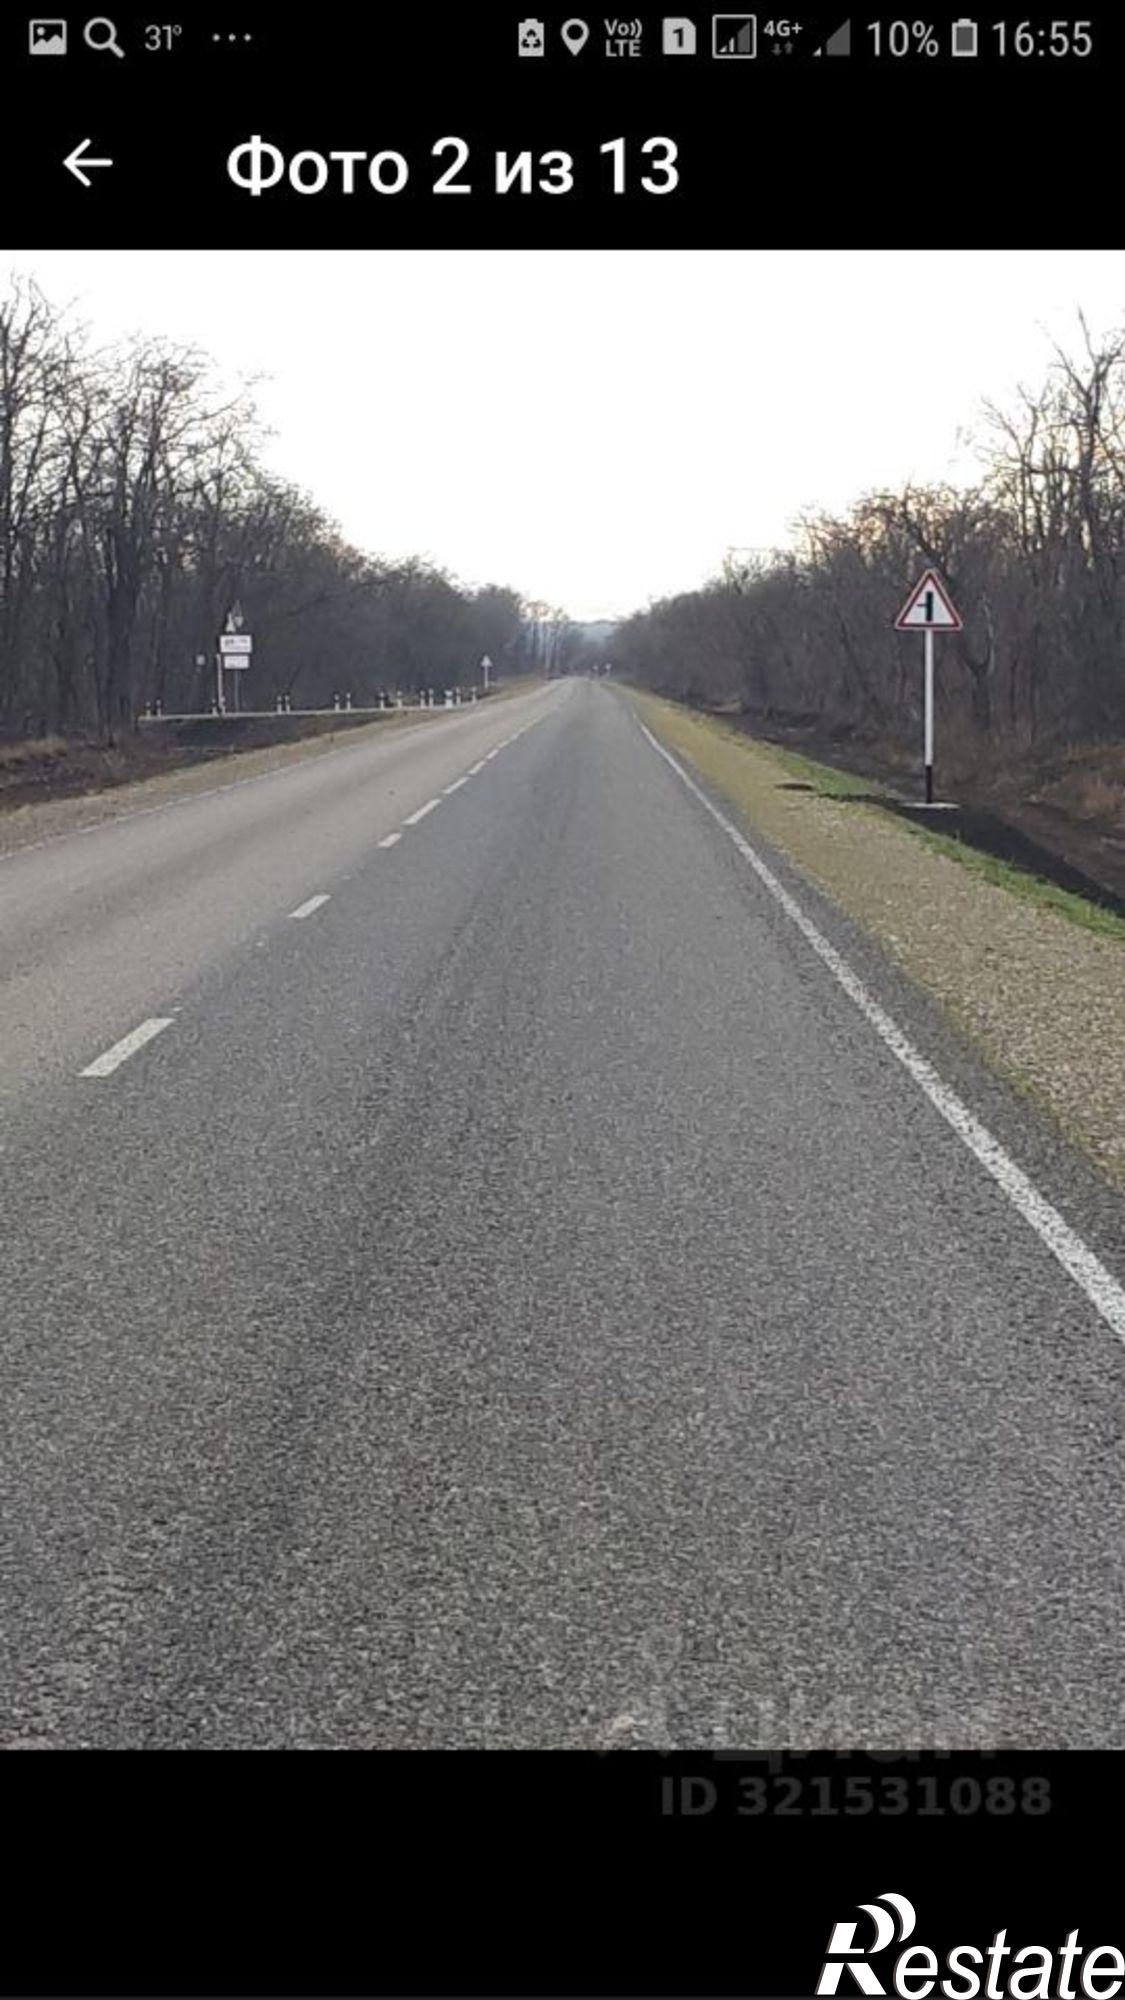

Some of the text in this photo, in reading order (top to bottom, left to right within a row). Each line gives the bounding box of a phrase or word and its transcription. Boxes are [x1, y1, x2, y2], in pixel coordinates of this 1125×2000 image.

[763, 19, 803, 37] 4G+
[867, 20, 939, 57] 10%
[992, 20, 1093, 57] 16:55
[605, 37, 641, 57] LTE
[226, 134, 680, 197] Фото 2 из 13
